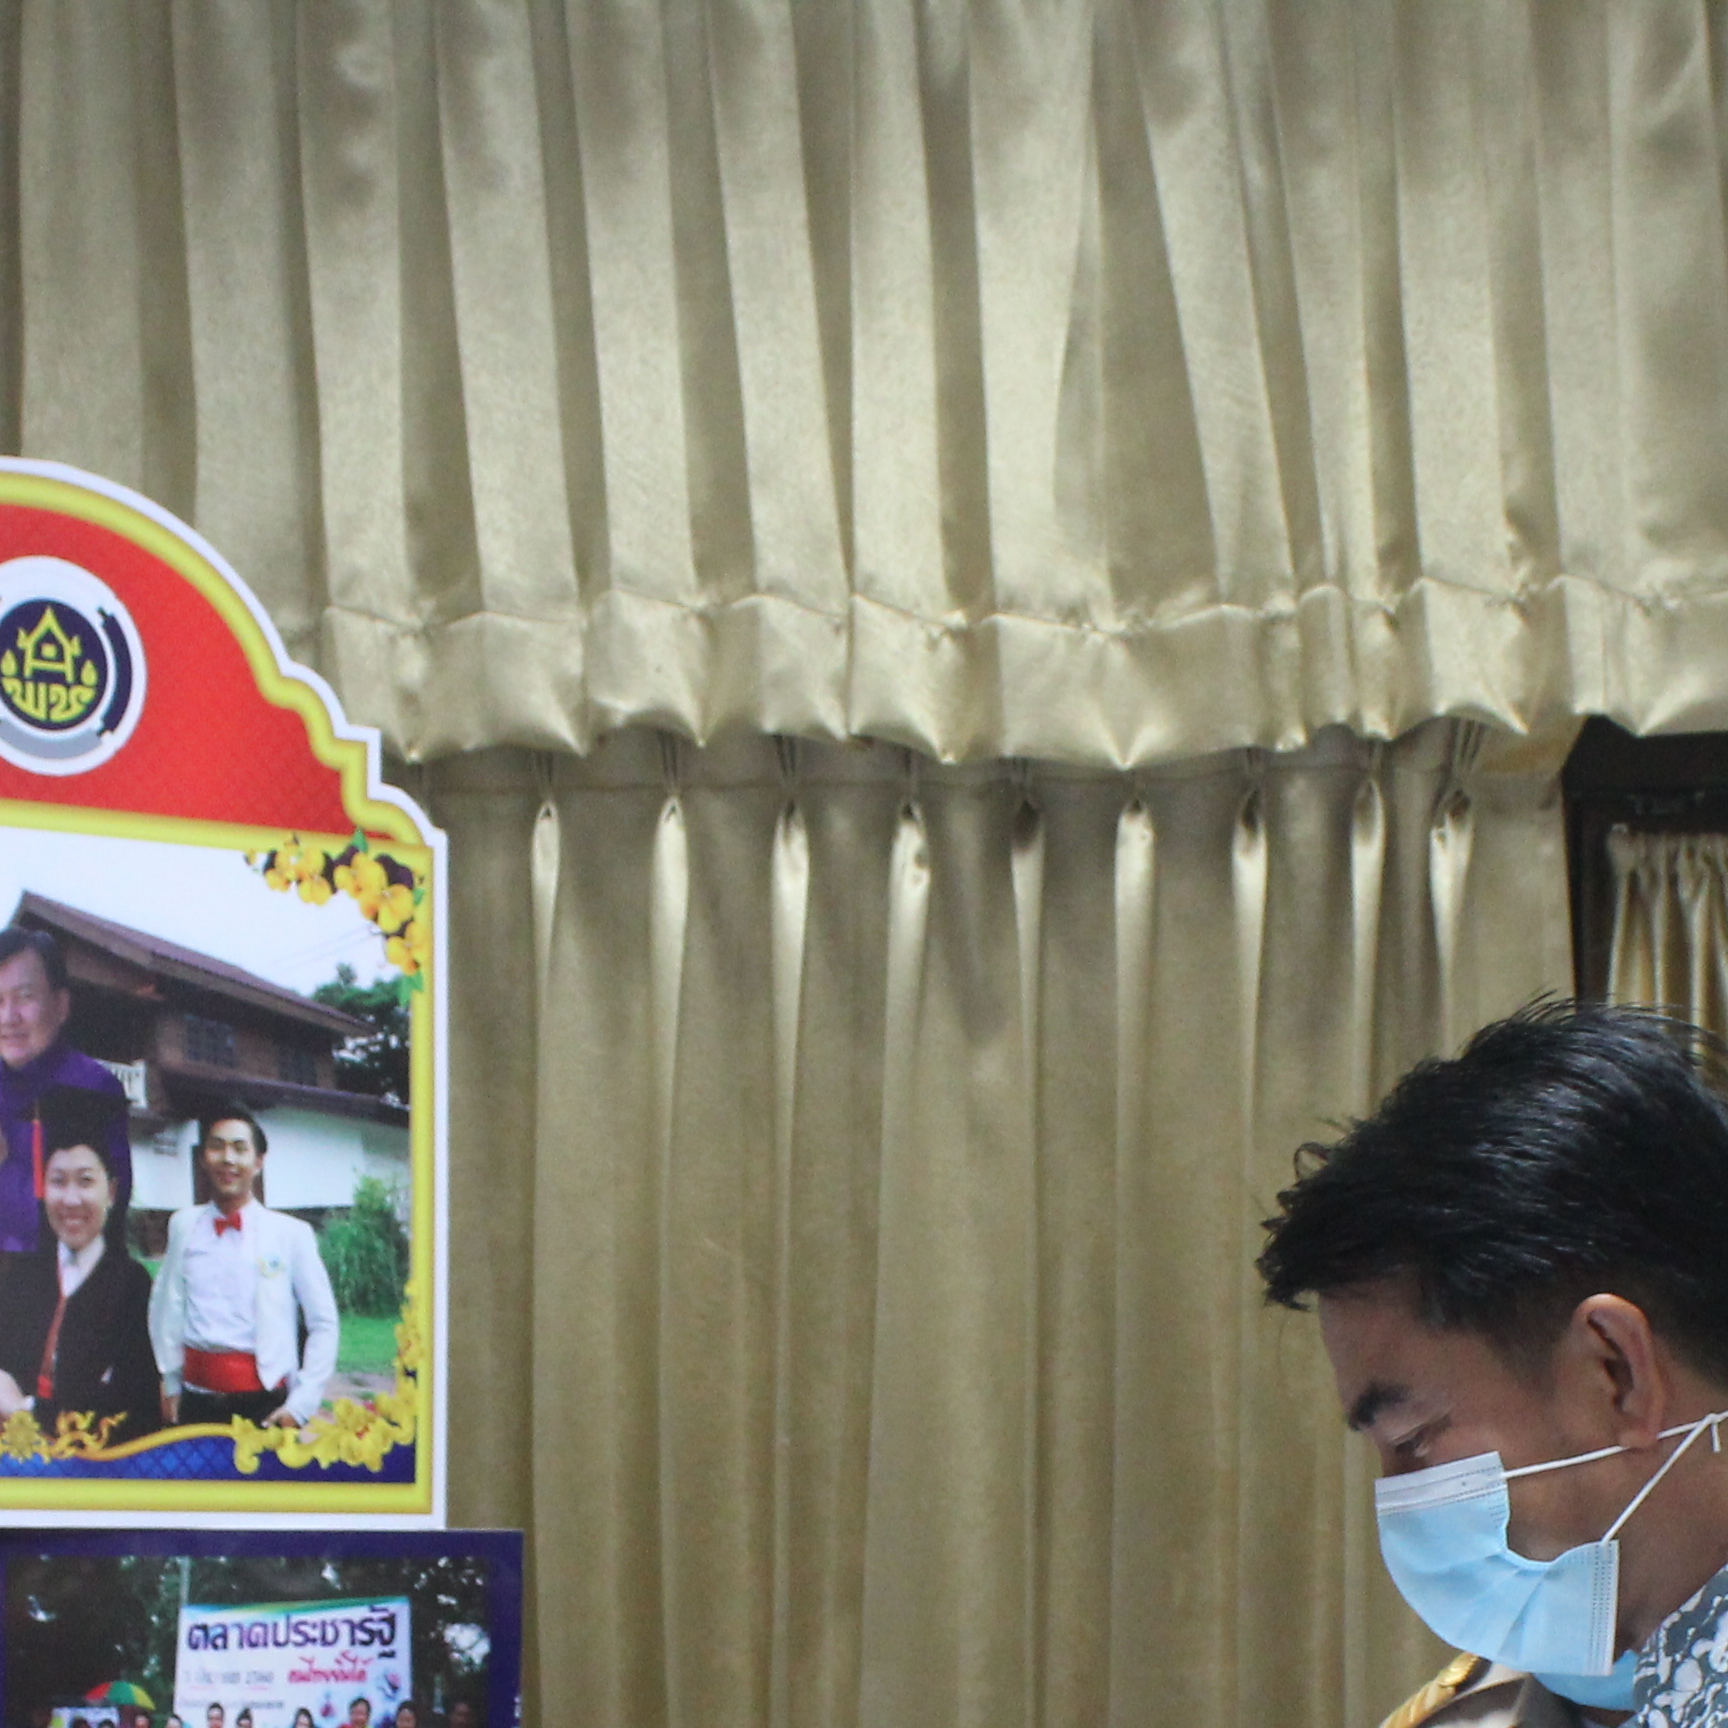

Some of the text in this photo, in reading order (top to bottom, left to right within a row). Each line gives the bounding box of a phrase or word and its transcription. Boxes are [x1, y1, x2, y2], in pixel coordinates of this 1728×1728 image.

[187, 1605, 397, 1659] ตลาดประชารัฐ
